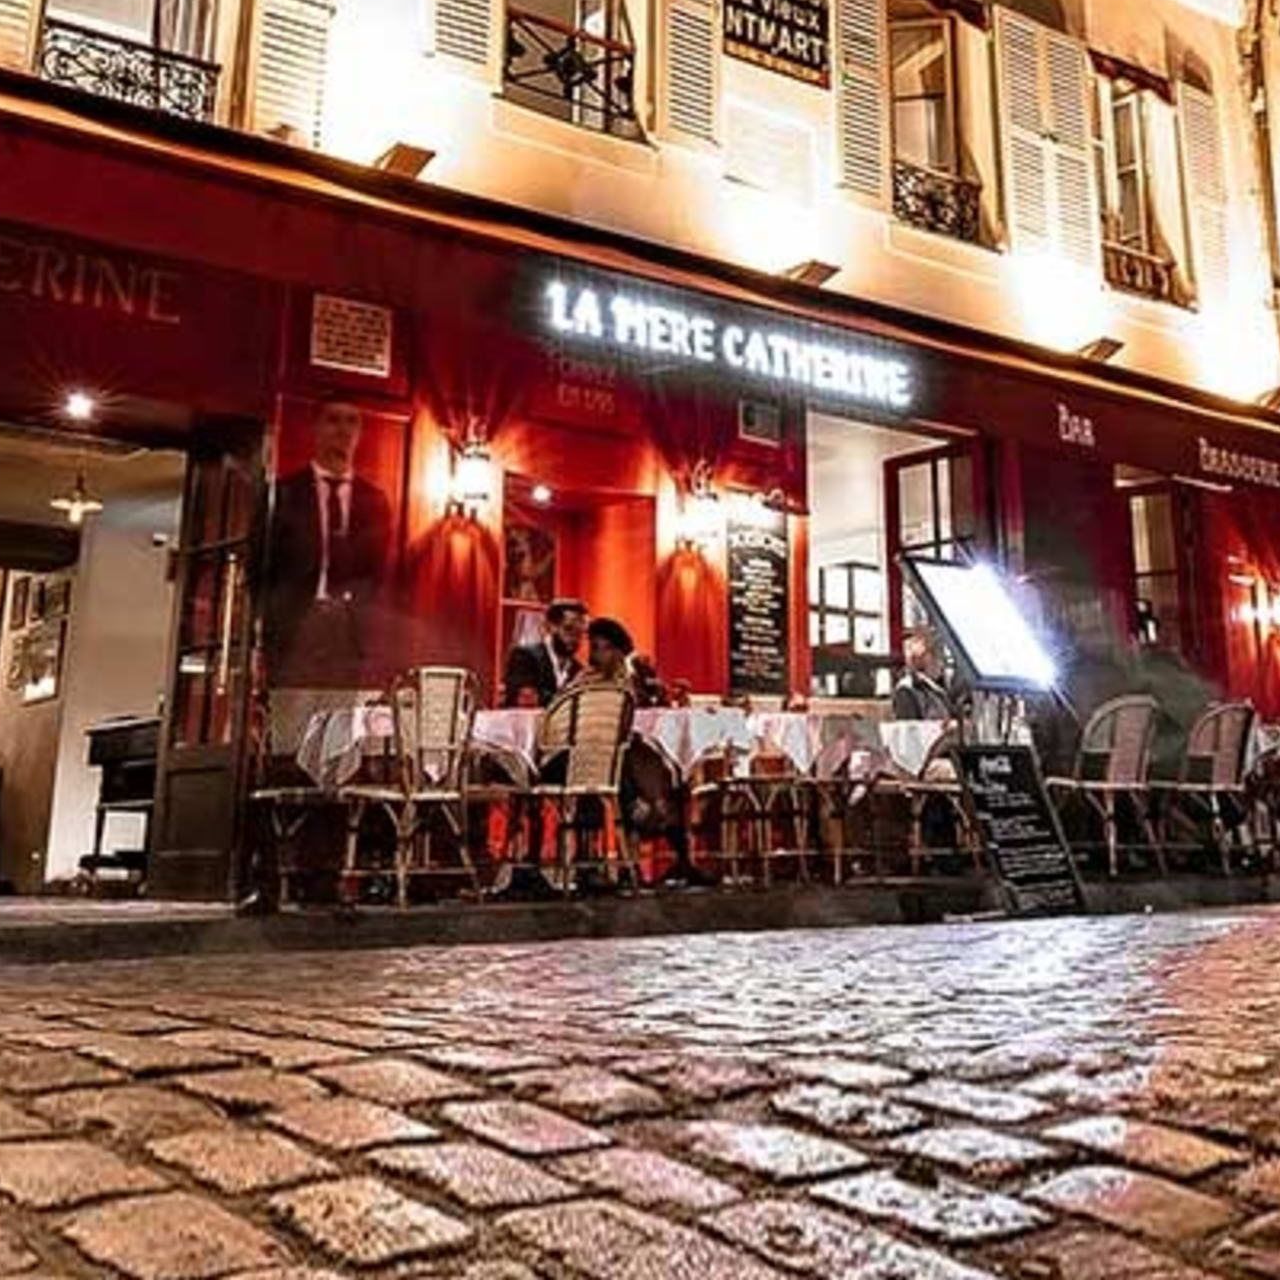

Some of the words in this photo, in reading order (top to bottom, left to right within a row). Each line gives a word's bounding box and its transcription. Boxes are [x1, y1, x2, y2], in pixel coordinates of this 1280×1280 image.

[545, 278, 603, 338] LA
[610, 294, 719, 364] MERE
[721, 323, 912, 408] CATHERINE
